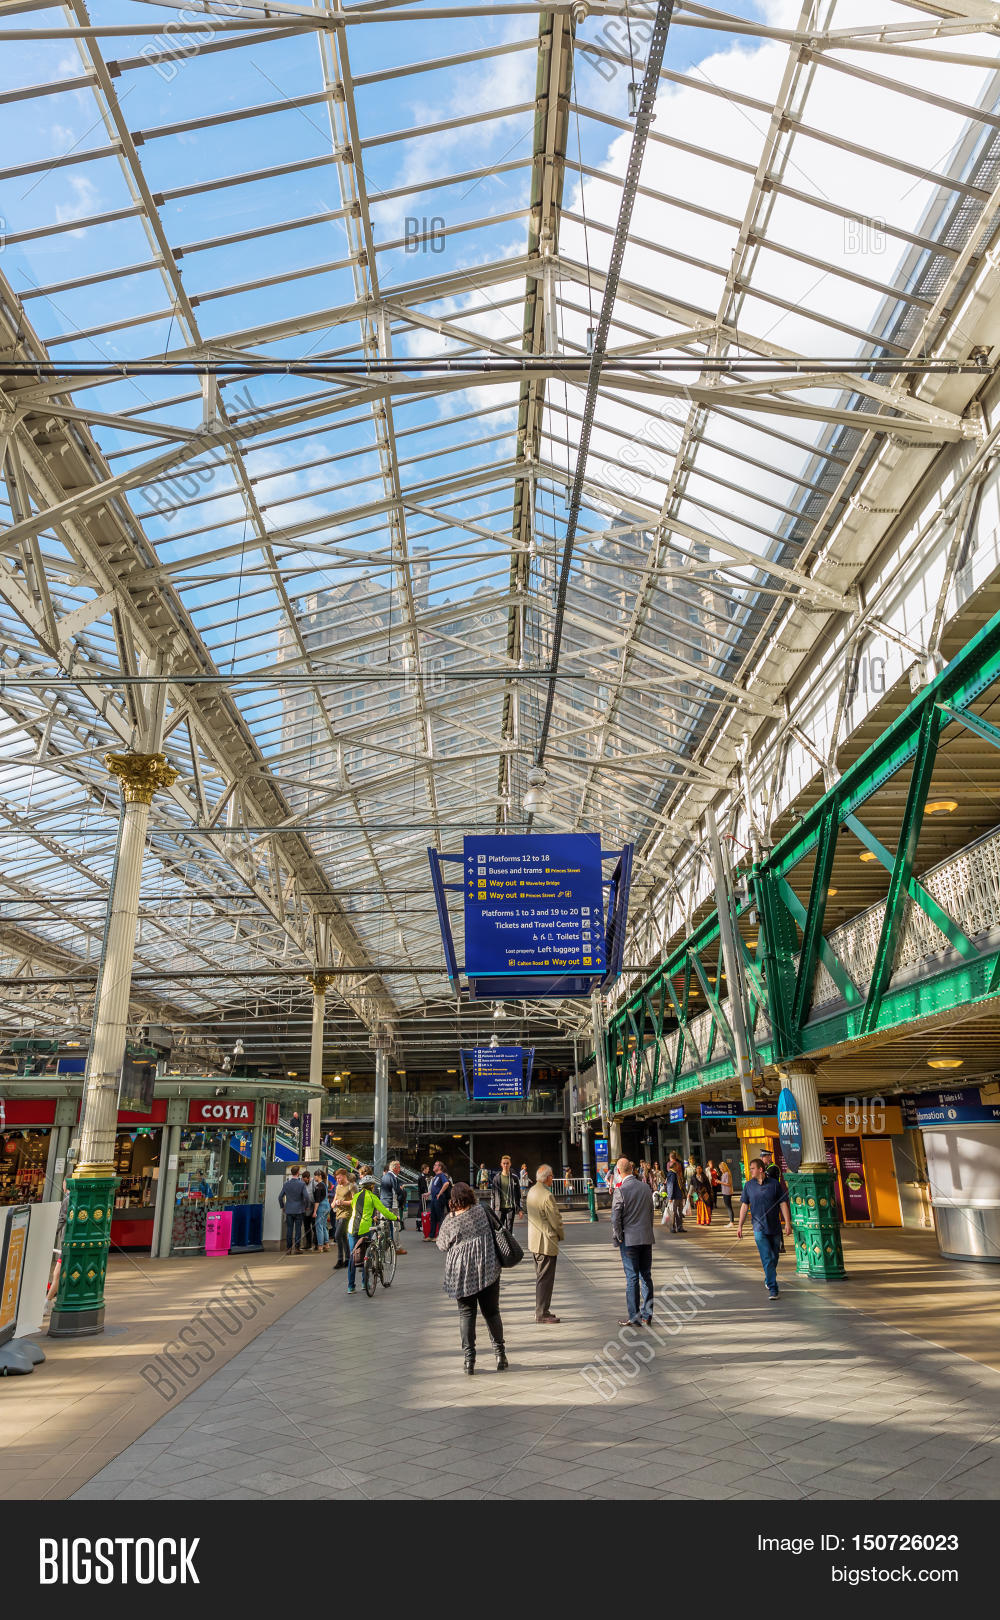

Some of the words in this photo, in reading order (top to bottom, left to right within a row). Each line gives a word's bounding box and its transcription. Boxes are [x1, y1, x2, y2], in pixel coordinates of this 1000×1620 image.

[488, 855, 521, 863] Platforms
[541, 854, 550, 862] 18
[488, 867, 509, 875] Buses
[489, 879, 504, 888] Way
[489, 892, 504, 900] Way
[481, 909, 514, 917] Platforms
[536, 908, 549, 916] and
[550, 908, 559, 916] 19
[495, 921, 519, 929] Tickets
[520, 921, 533, 929] and
[534, 920, 555, 928] Travel
[556, 920, 579, 928] Centre
[552, 945, 580, 954] luggage
[552, 958, 567, 967] Way
[201, 1104, 249, 1120] COSTA
[836, 1114, 876, 1126] CRUST
